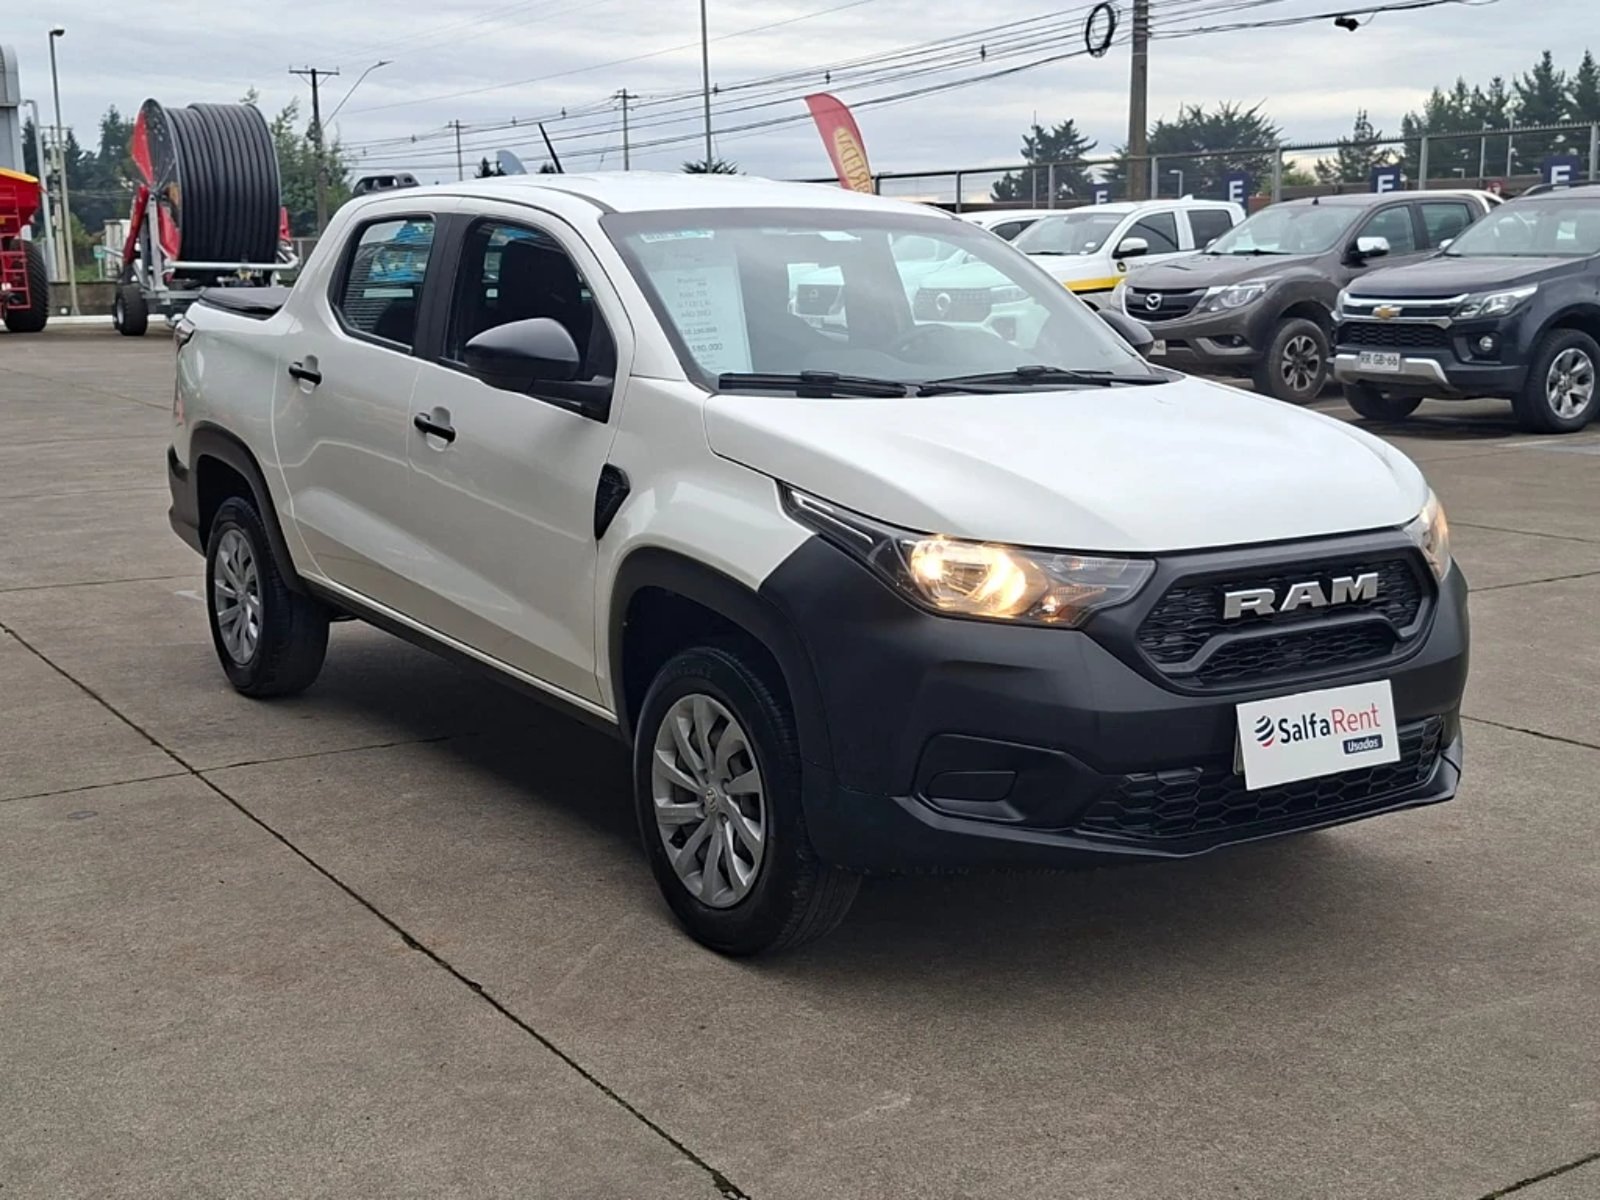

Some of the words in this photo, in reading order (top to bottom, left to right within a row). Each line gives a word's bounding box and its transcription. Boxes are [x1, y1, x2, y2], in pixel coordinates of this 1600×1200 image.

[1229, 180, 1244, 202] E
[1223, 572, 1379, 619] RAM
[1278, 702, 1380, 744] SalfaRent
[1347, 738, 1379, 752] Usados
